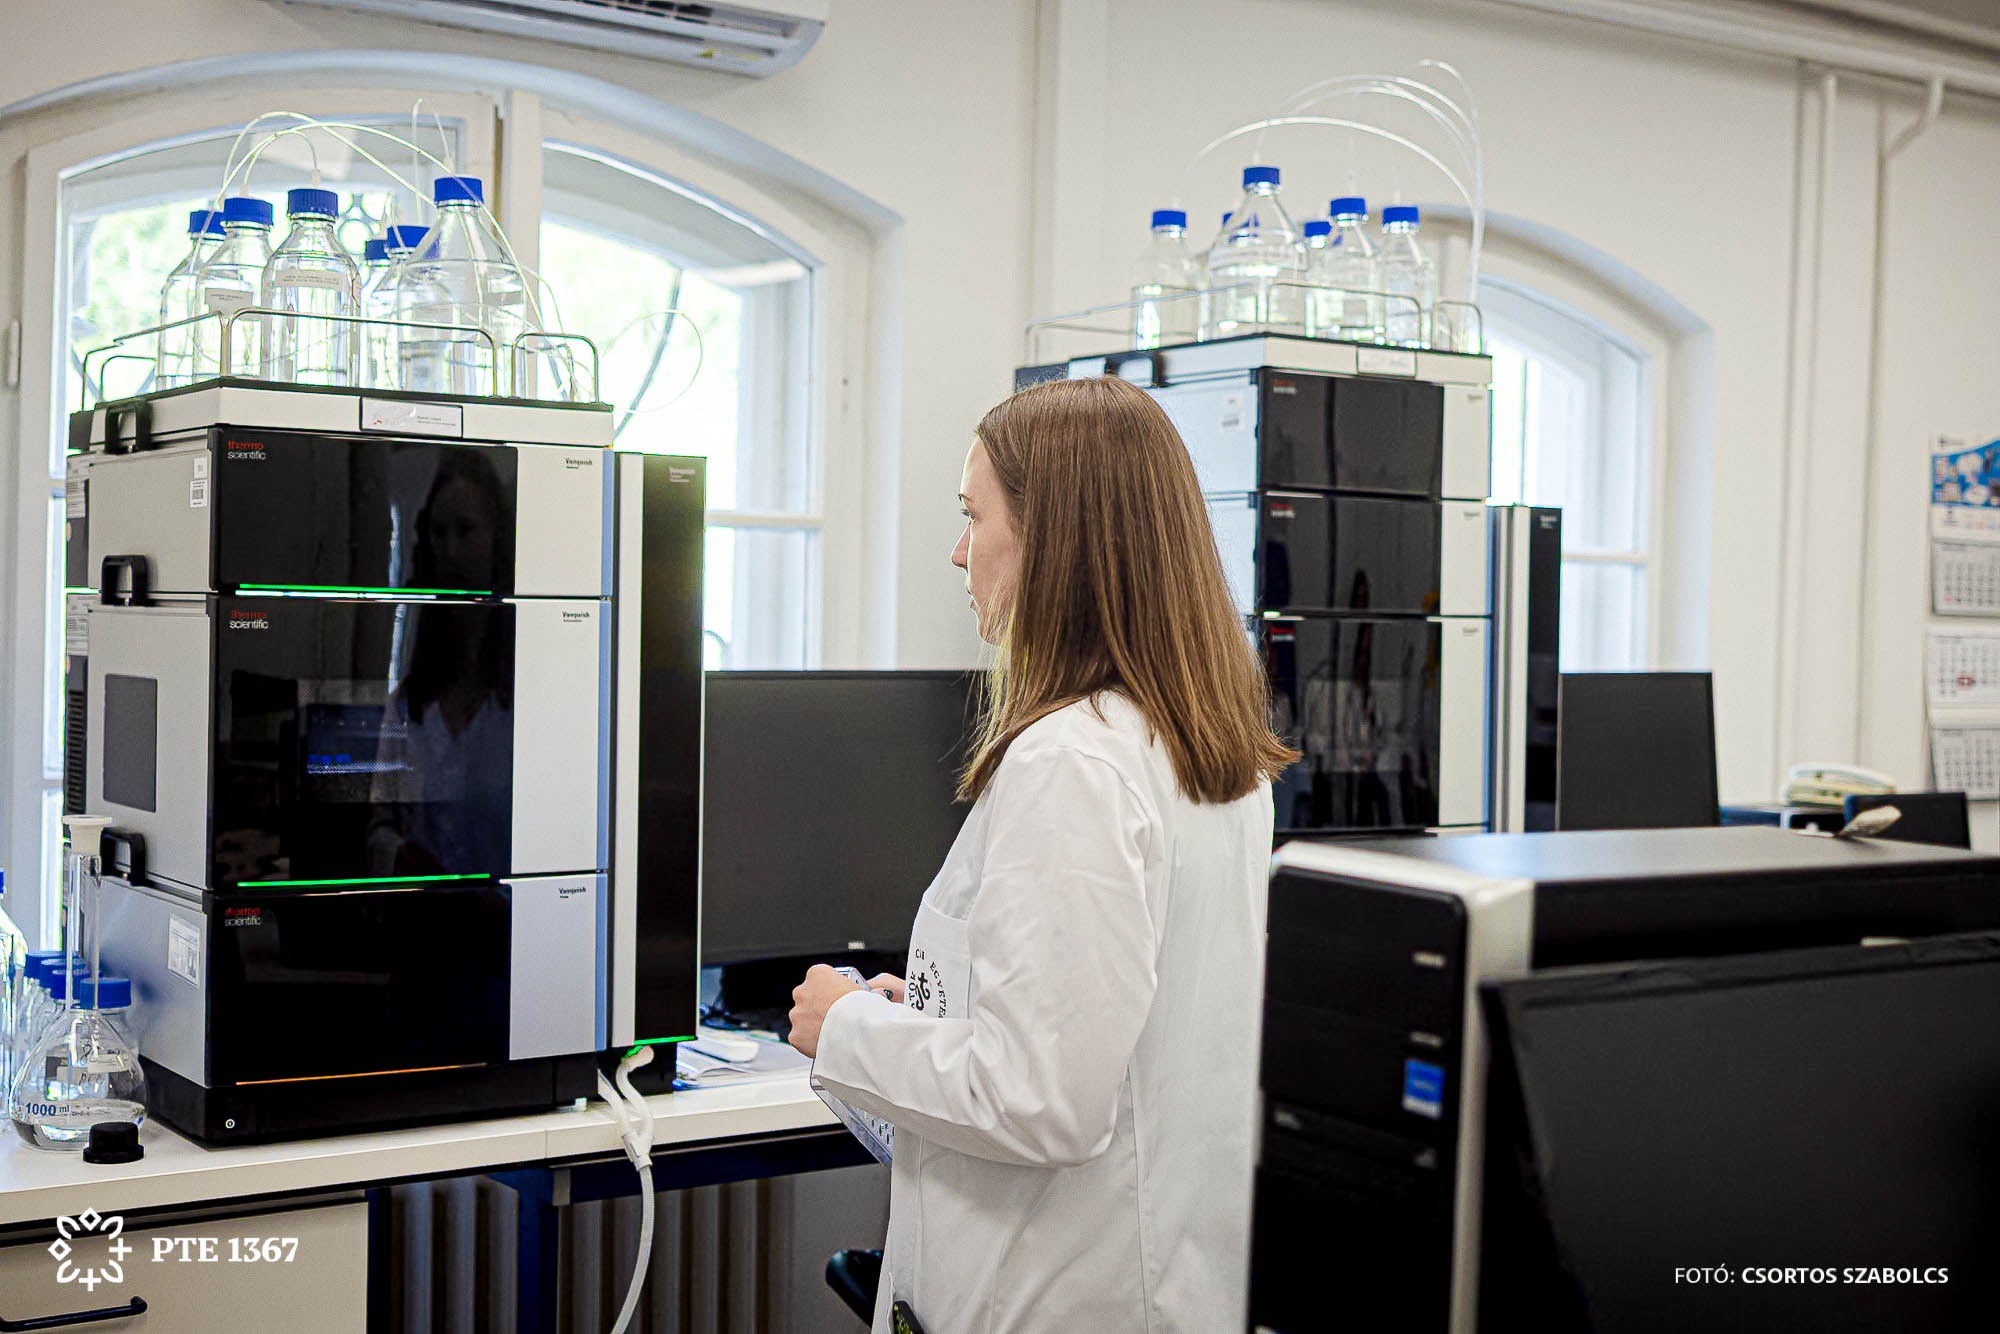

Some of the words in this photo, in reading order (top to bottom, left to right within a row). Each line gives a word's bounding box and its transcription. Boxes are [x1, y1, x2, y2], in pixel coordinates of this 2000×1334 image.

[227, 440, 264, 450] thermo
[227, 451, 266, 460] scientific
[229, 619, 269, 629] scientific
[25, 1103, 57, 1116] 1000
[59, 1104, 70, 1113] ml
